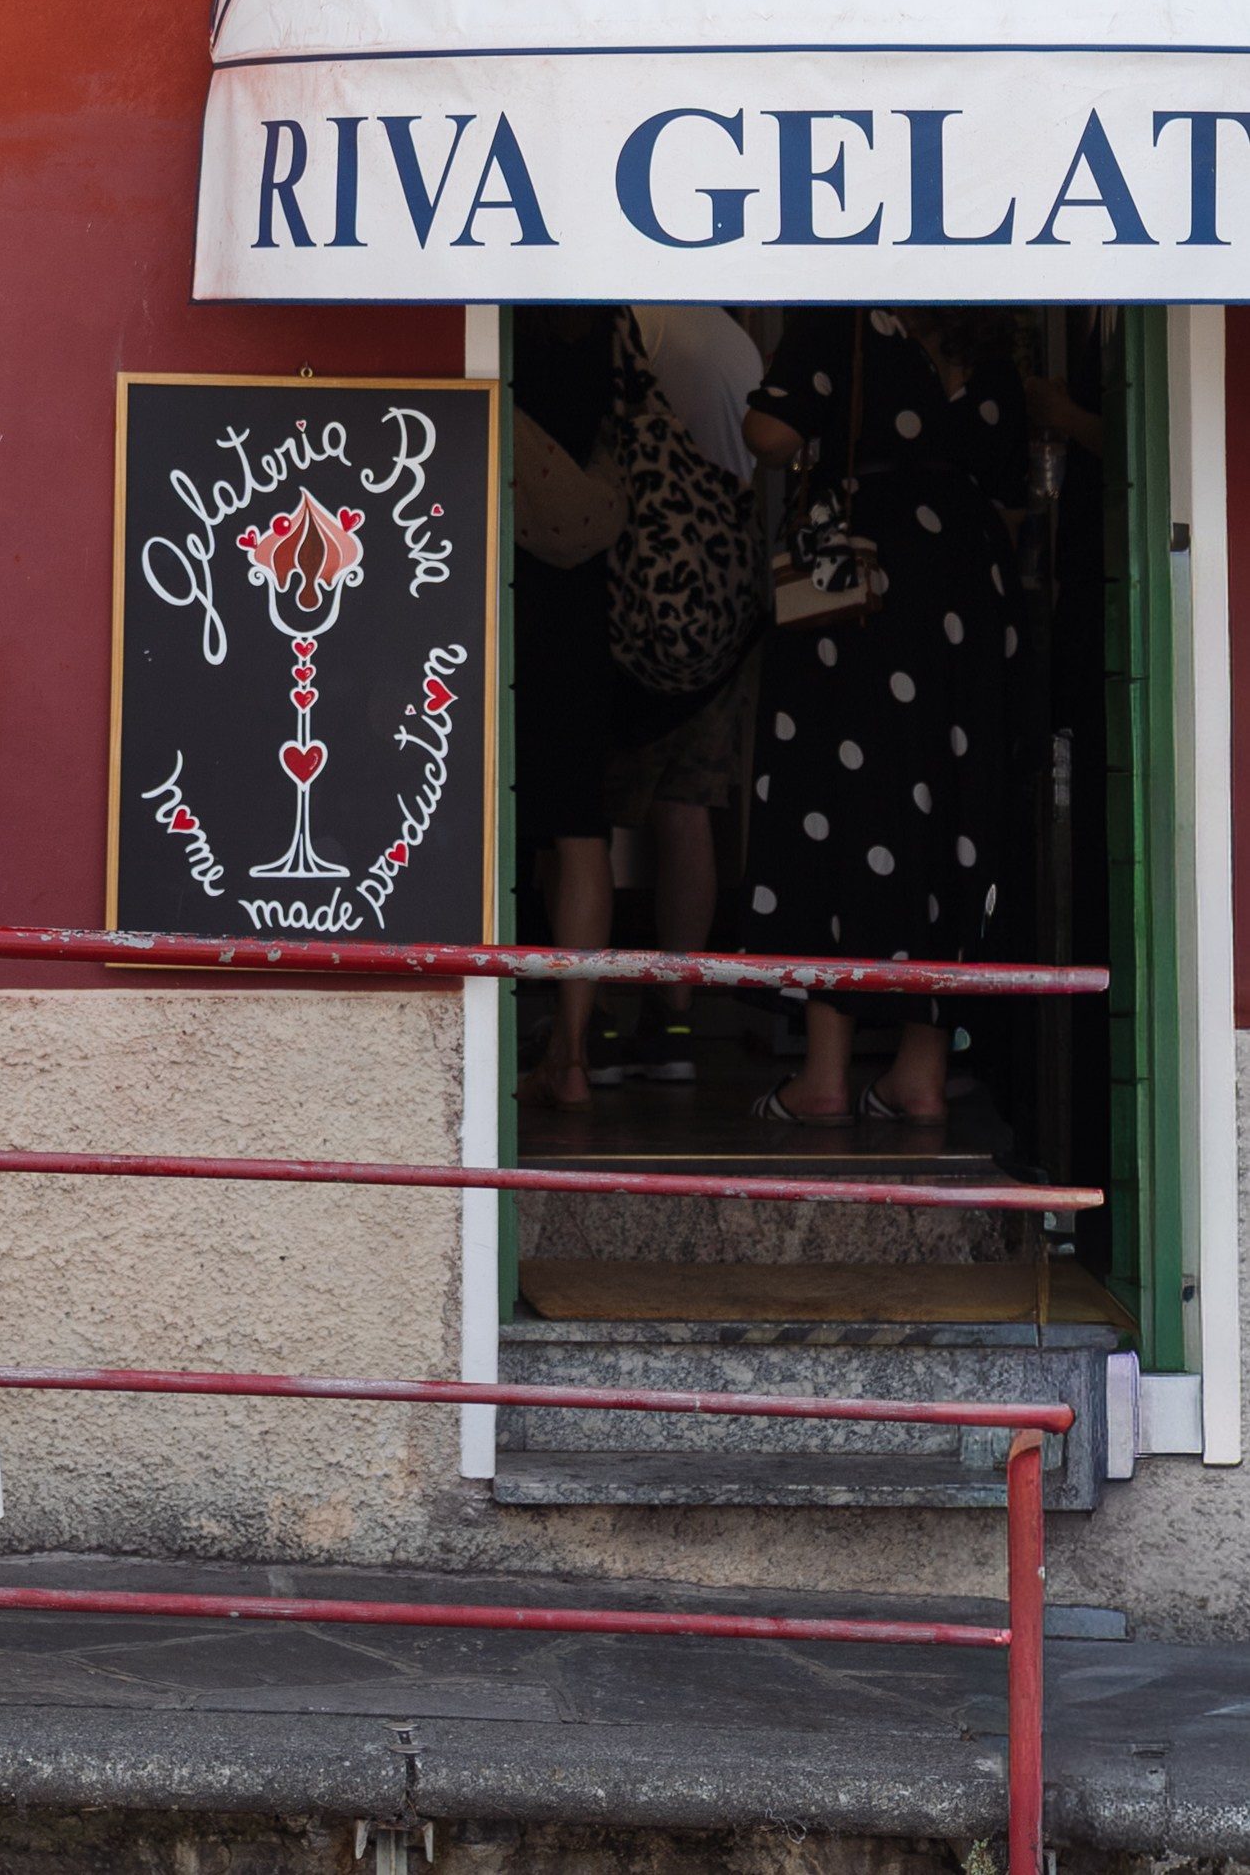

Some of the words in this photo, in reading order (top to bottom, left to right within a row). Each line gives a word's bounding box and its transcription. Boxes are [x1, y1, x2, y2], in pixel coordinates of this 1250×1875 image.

[250, 110, 560, 250] RIVA
[615, 107, 1250, 249] GELAT
[360, 406, 453, 599] Riva
[238, 886, 364, 933] made
